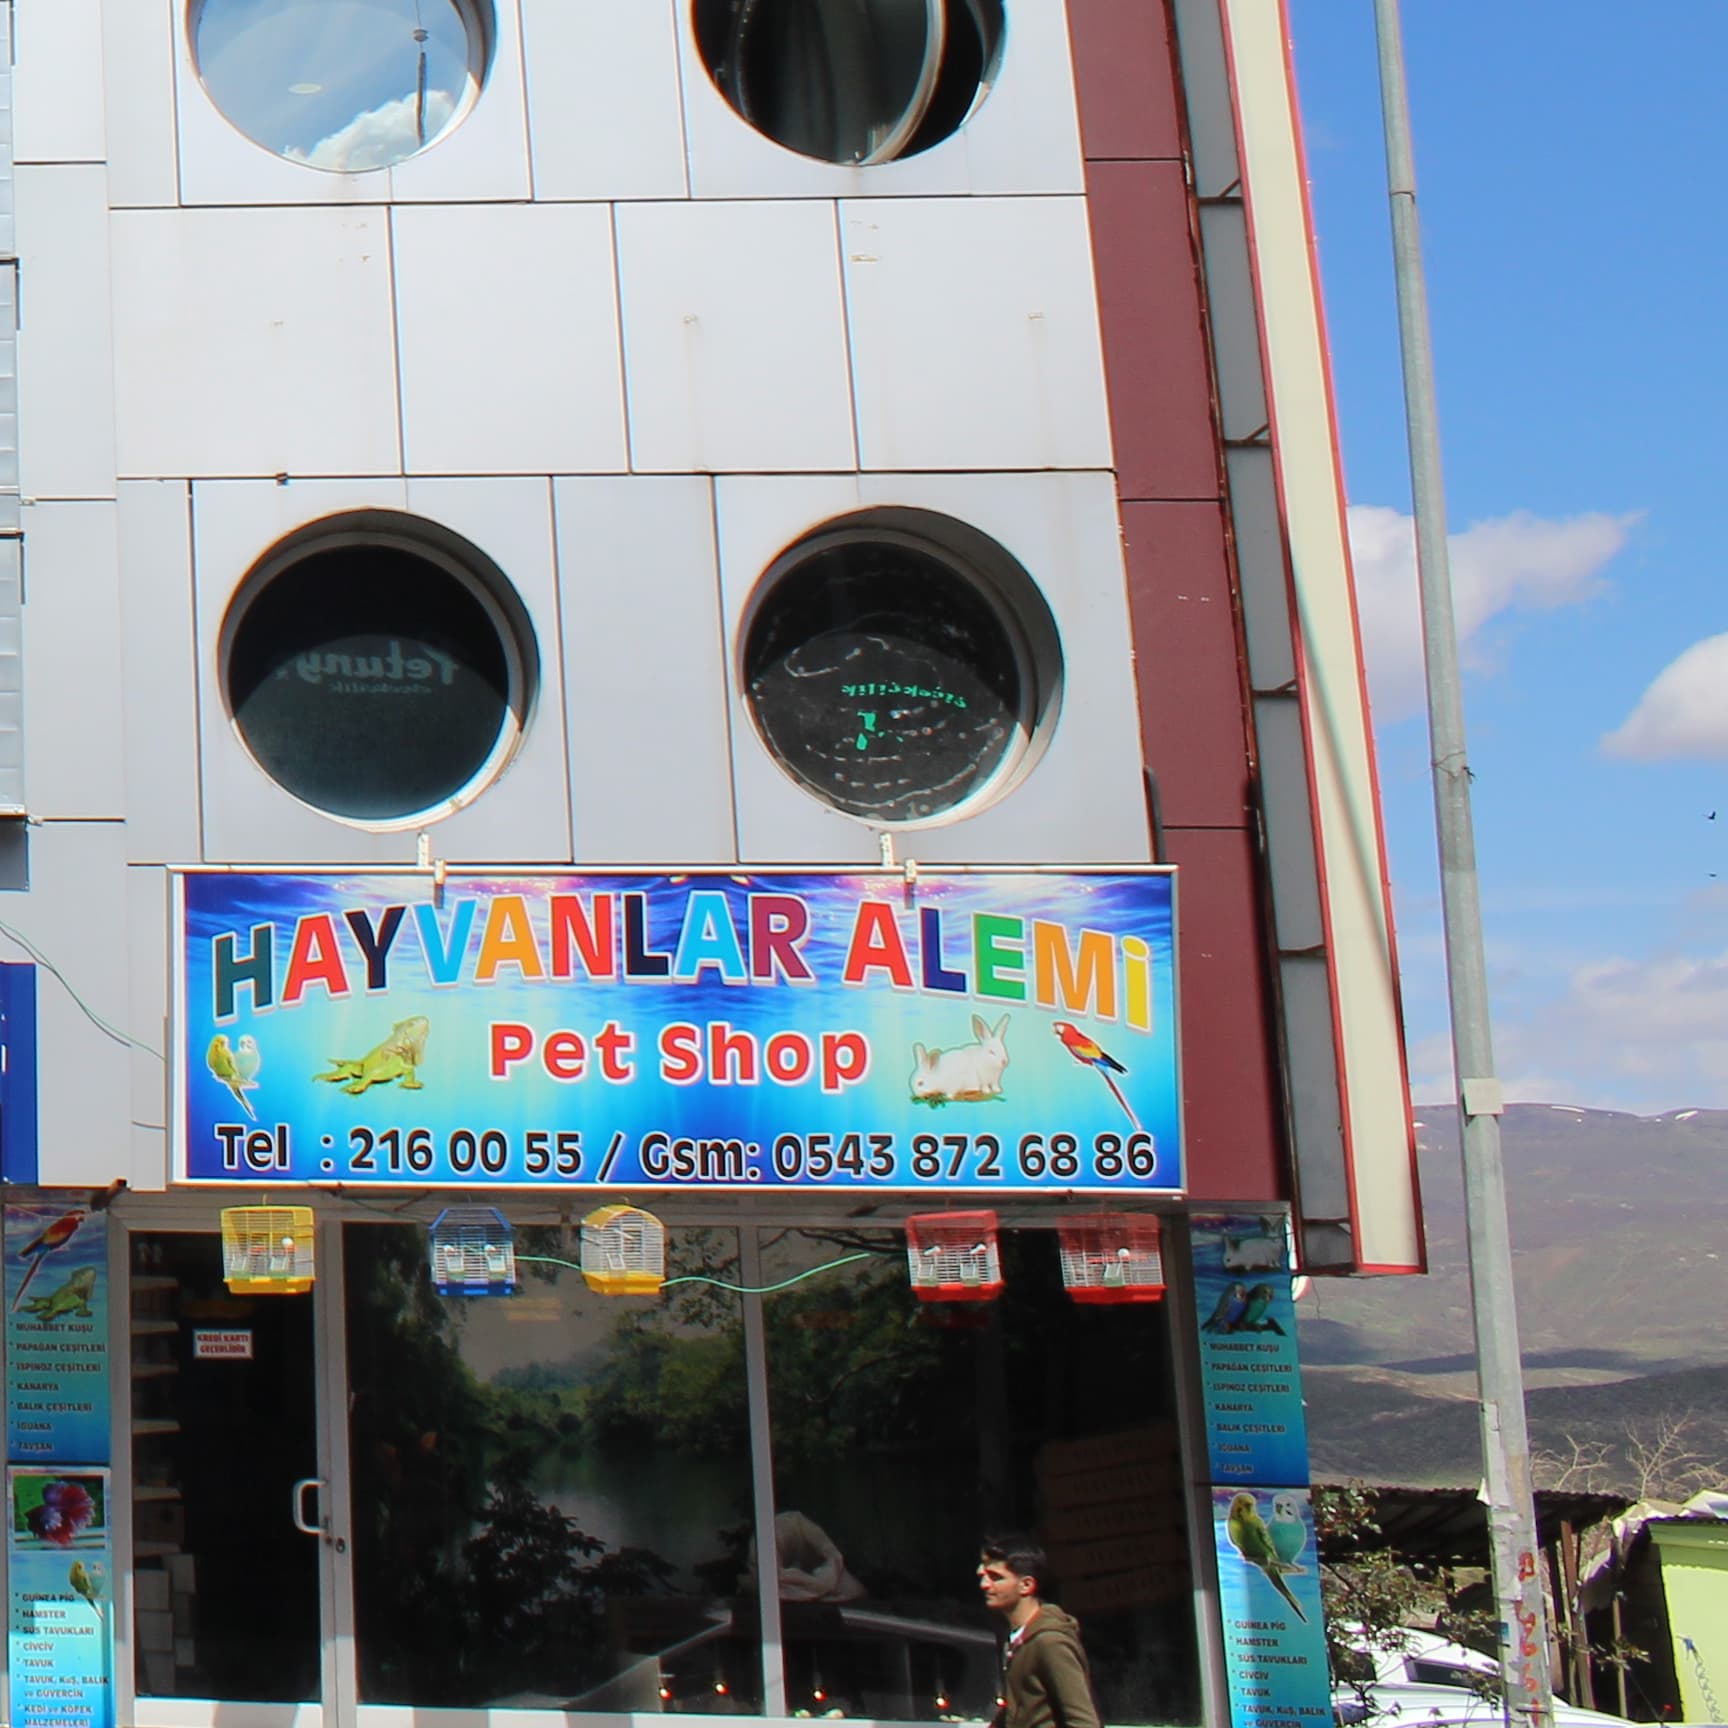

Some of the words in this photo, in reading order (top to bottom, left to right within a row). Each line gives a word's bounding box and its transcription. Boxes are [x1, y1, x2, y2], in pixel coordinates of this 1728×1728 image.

[212, 891, 817, 1025] HAYVANLAR
[488, 1020, 636, 1085] Pet
[659, 1020, 871, 1095] Shop
[215, 1122, 289, 1172] Tel
[348, 1127, 433, 1173] 216
[448, 1130, 508, 1175] 00
[523, 1131, 583, 1176] 55
[772, 1131, 897, 1179] 0543
[910, 1132, 1003, 1180] 872
[1017, 1132, 1080, 1180] 68
[1093, 1130, 1157, 1179] 86
